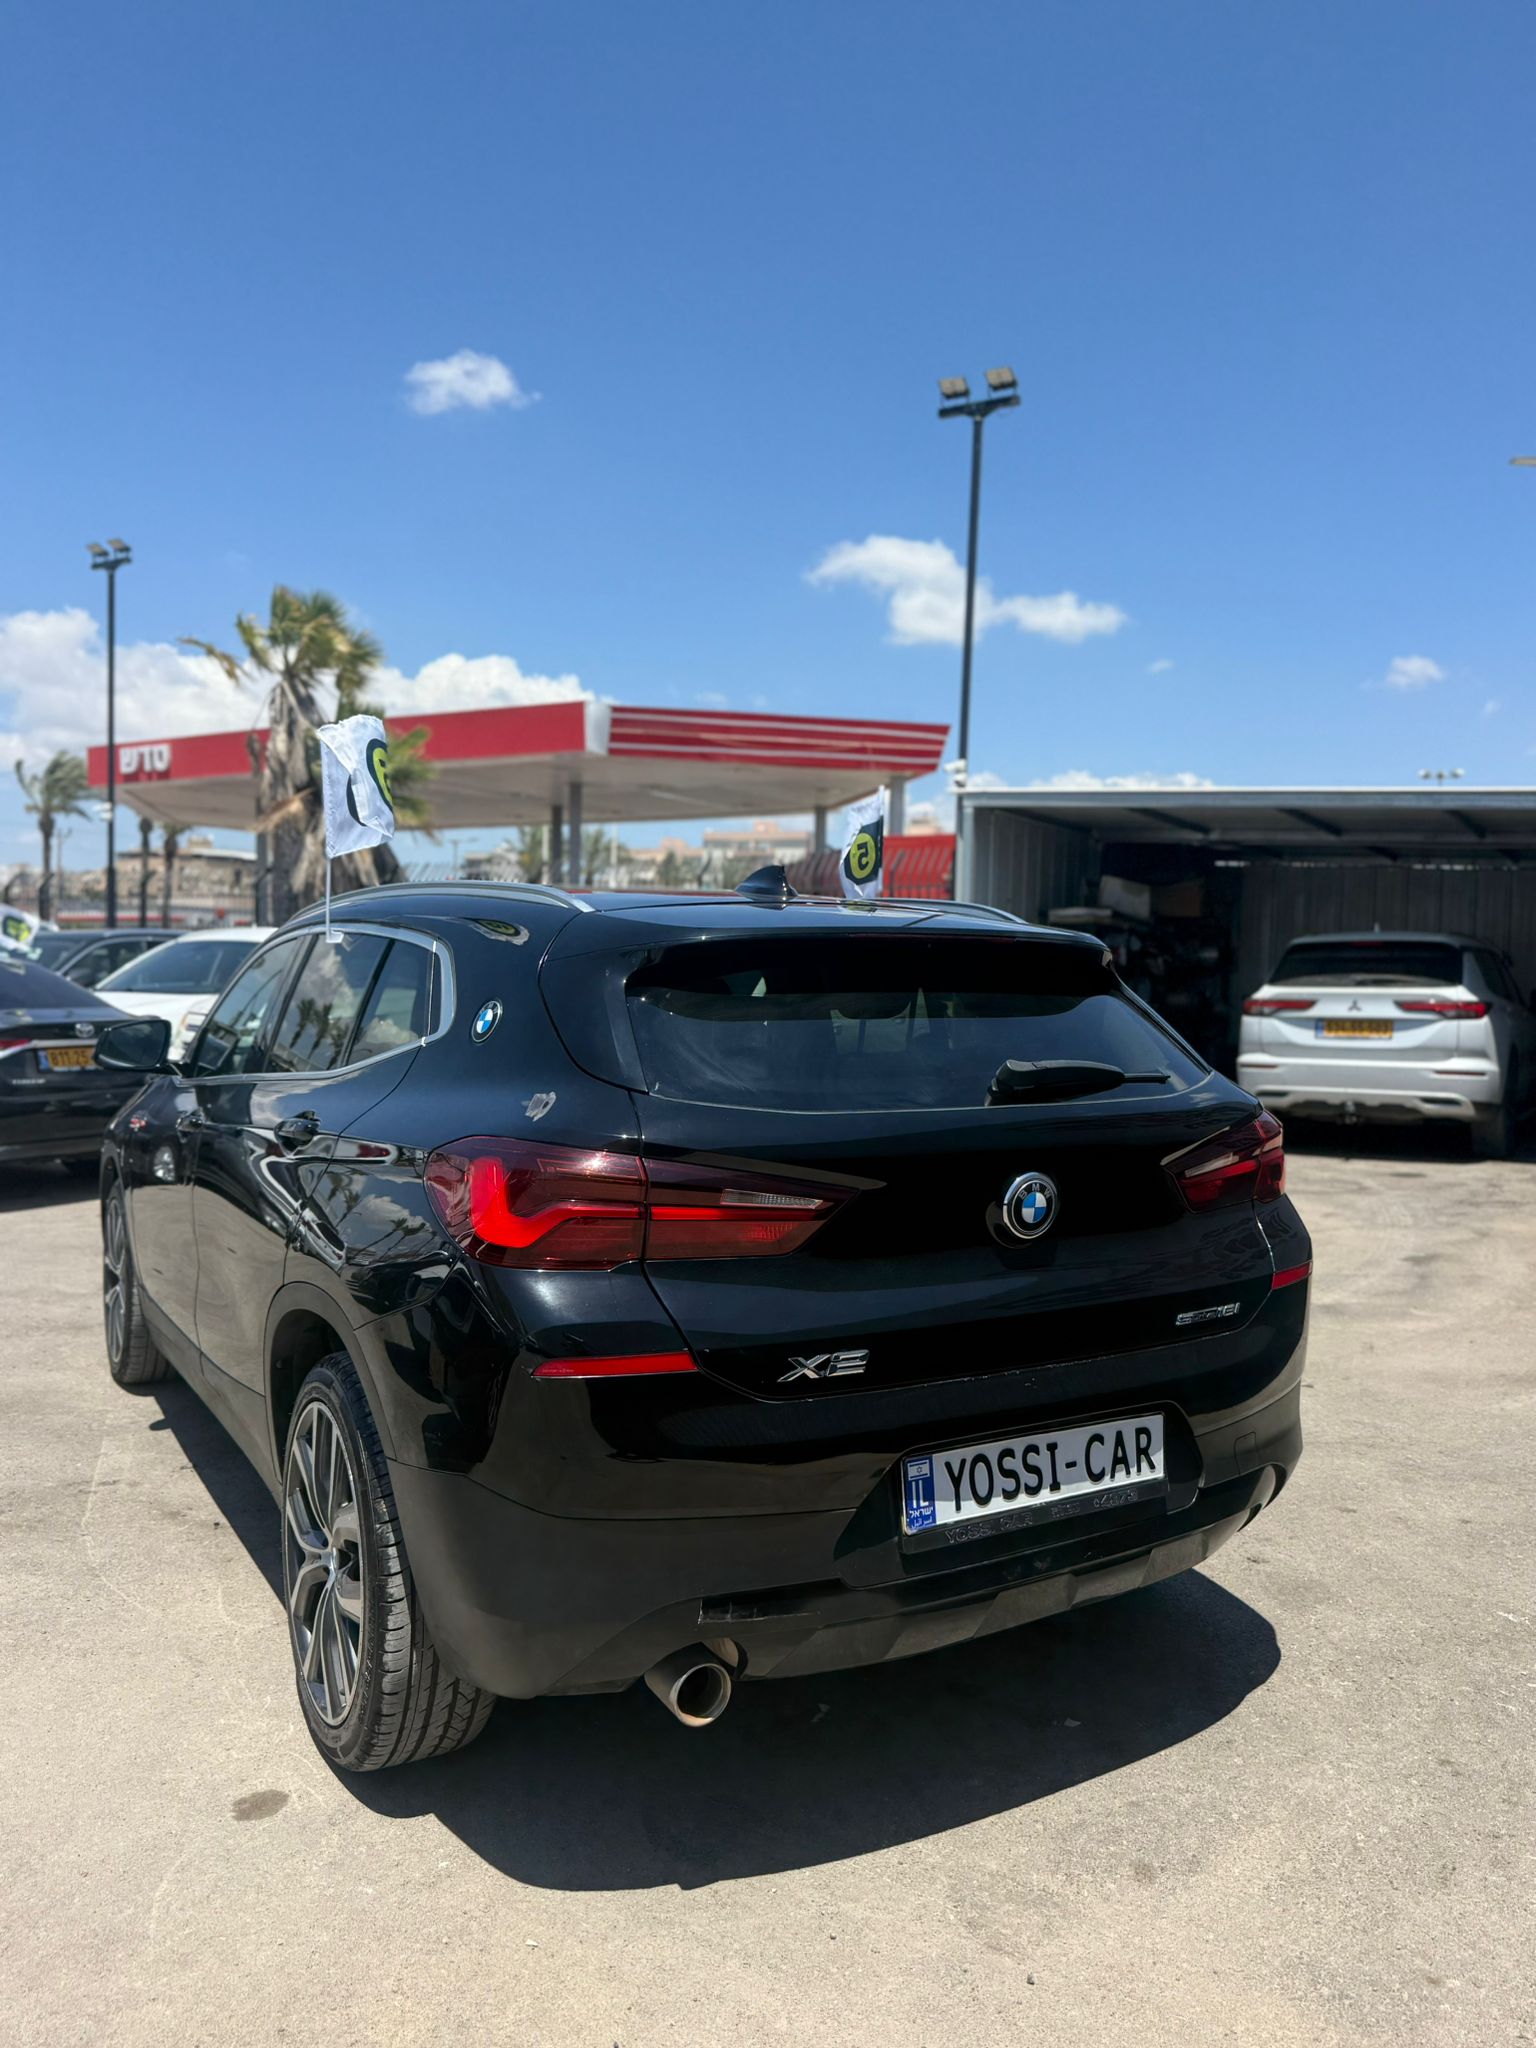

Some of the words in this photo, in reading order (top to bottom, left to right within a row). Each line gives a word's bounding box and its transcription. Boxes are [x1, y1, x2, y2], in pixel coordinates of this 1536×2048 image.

[1018, 1183, 1052, 1200] BMW
[777, 1349, 870, 1382] X2
[944, 1426, 1156, 1513] YOSSI-CAR
[911, 1480, 930, 1509] IL
[909, 1507, 934, 1519] ישראל
